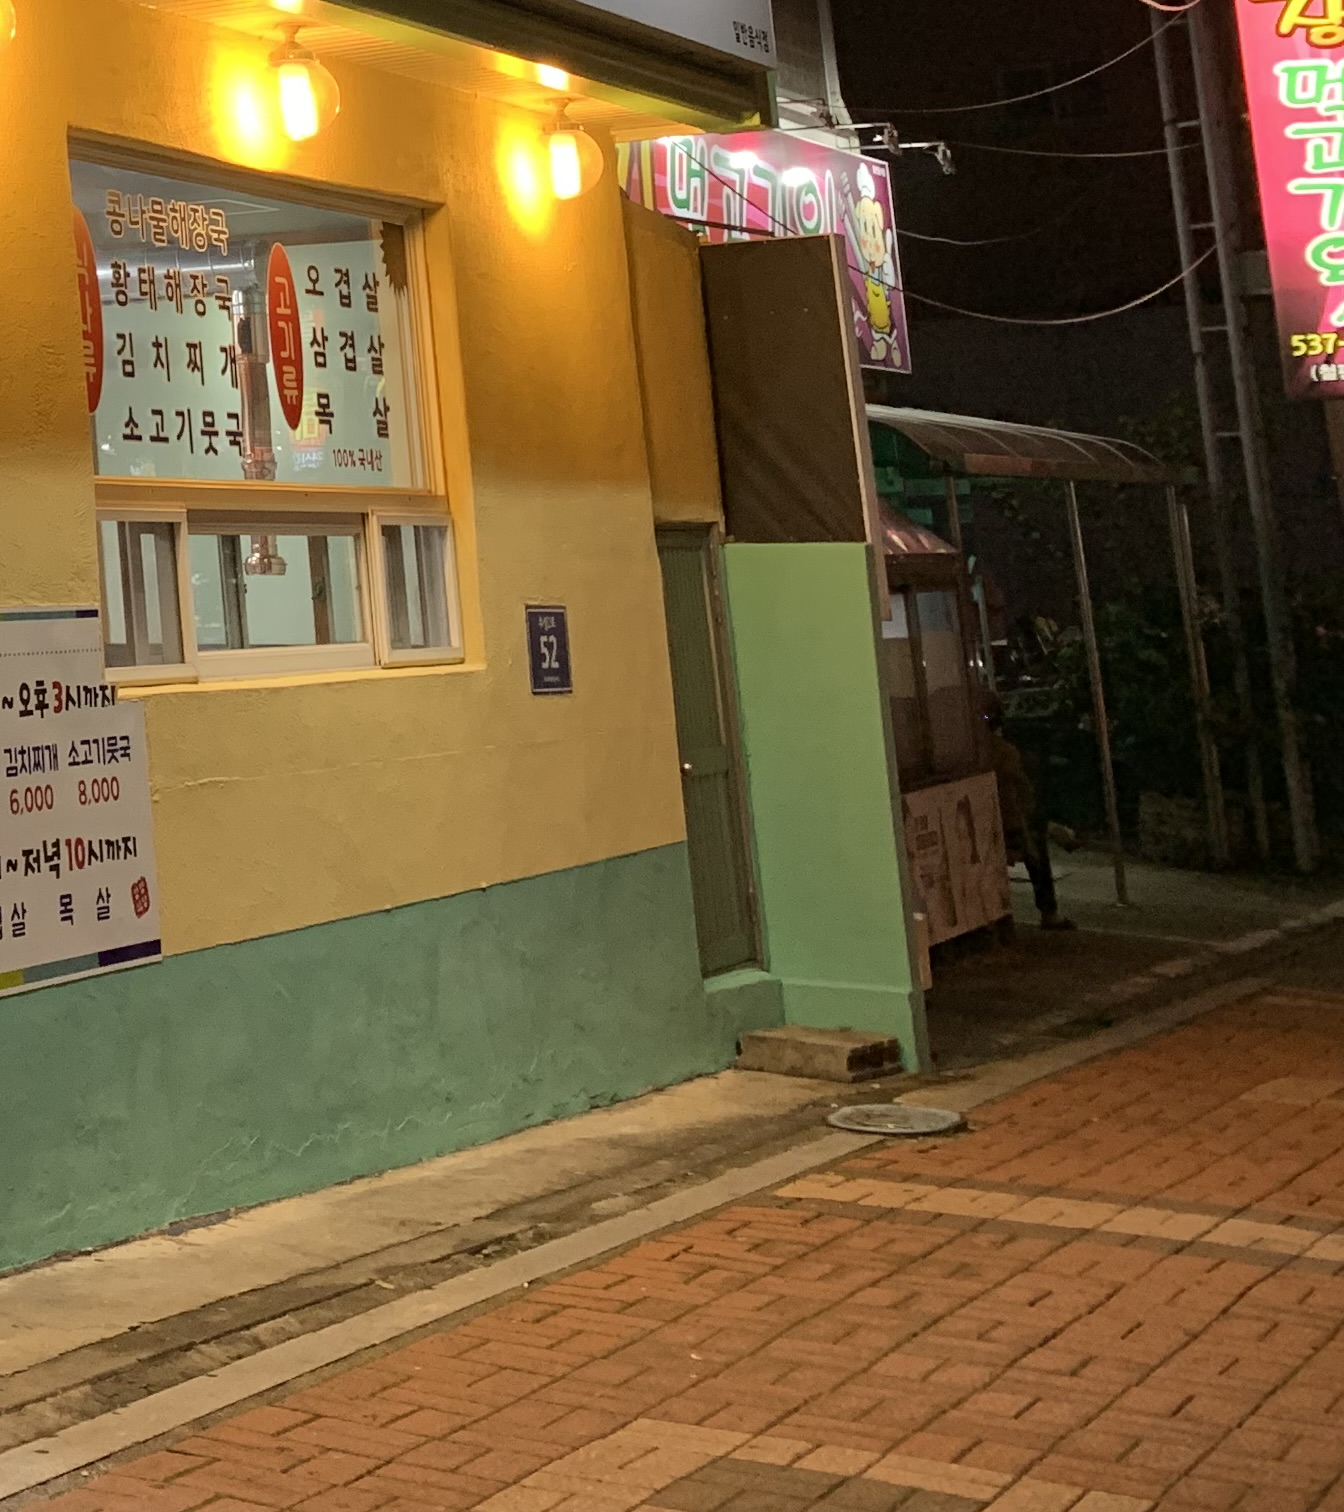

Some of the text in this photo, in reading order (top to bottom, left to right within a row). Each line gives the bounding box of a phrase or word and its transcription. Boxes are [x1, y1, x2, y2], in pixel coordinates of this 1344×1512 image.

[106, 189, 229, 256] 콩나물해장국
[110, 260, 233, 322] 황태해장국
[304, 264, 380, 313] 오겹살
[116, 332, 239, 388] 김치찌개
[274, 275, 300, 406] 고기류
[309, 326, 385, 376] 삼겹살
[122, 405, 244, 457] 소고기뭇국
[332, 448, 383, 472] 100% 국내산
[539, 634, 560, 669] 52
[4, 743, 60, 778] 김치찌개
[68, 735, 132, 768] 소고기뭇국
[9, 784, 55, 816] 6,000
[77, 776, 121, 807] 8,000
